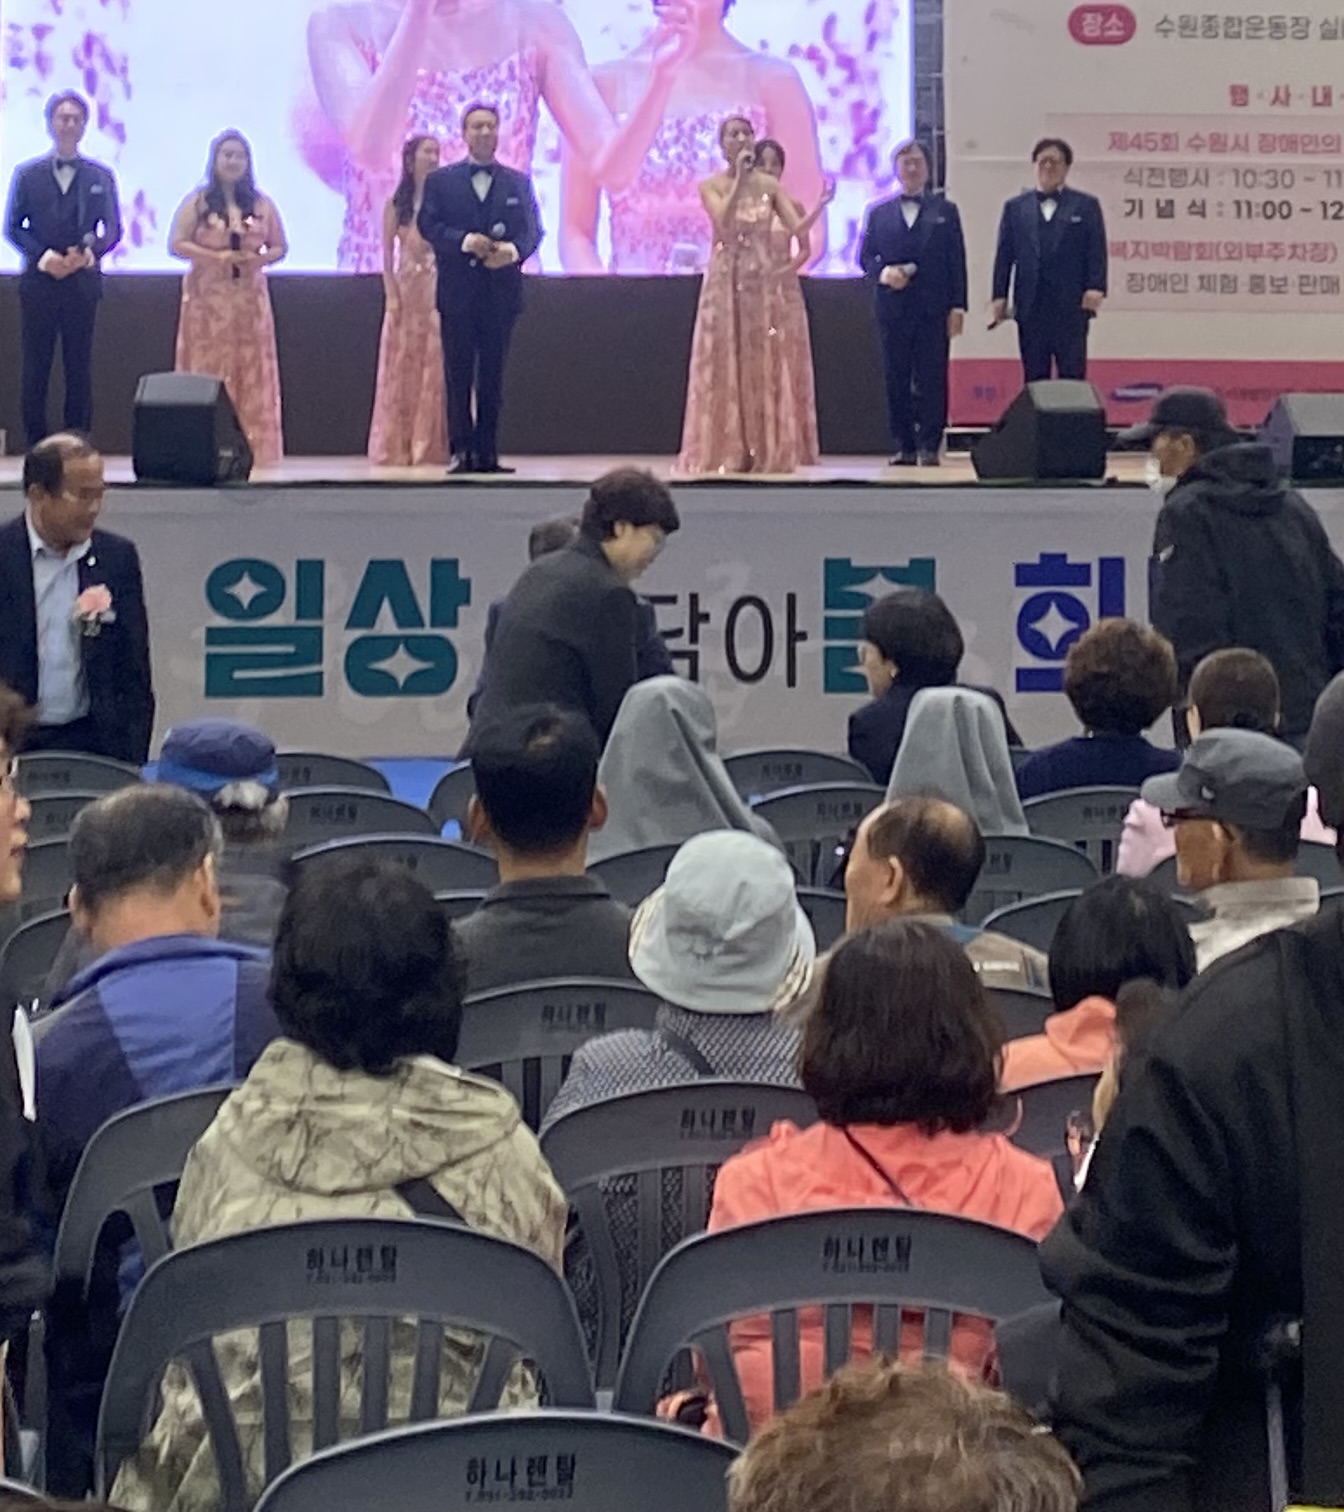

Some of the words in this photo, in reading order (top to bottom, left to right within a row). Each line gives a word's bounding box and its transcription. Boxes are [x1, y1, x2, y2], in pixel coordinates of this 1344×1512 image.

[1081, 12, 1125, 37] 장소
[1155, 14, 1311, 41] 수원종합운동장
[1108, 131, 1179, 152] 제45회
[1187, 132, 1250, 153] 수원시
[1258, 133, 1342, 155] 장애인의
[1232, 169, 1296, 189] 10:30
[1233, 199, 1293, 220] 11:00
[1126, 272, 1189, 294] 장애인
[205, 558, 471, 697] 일상
